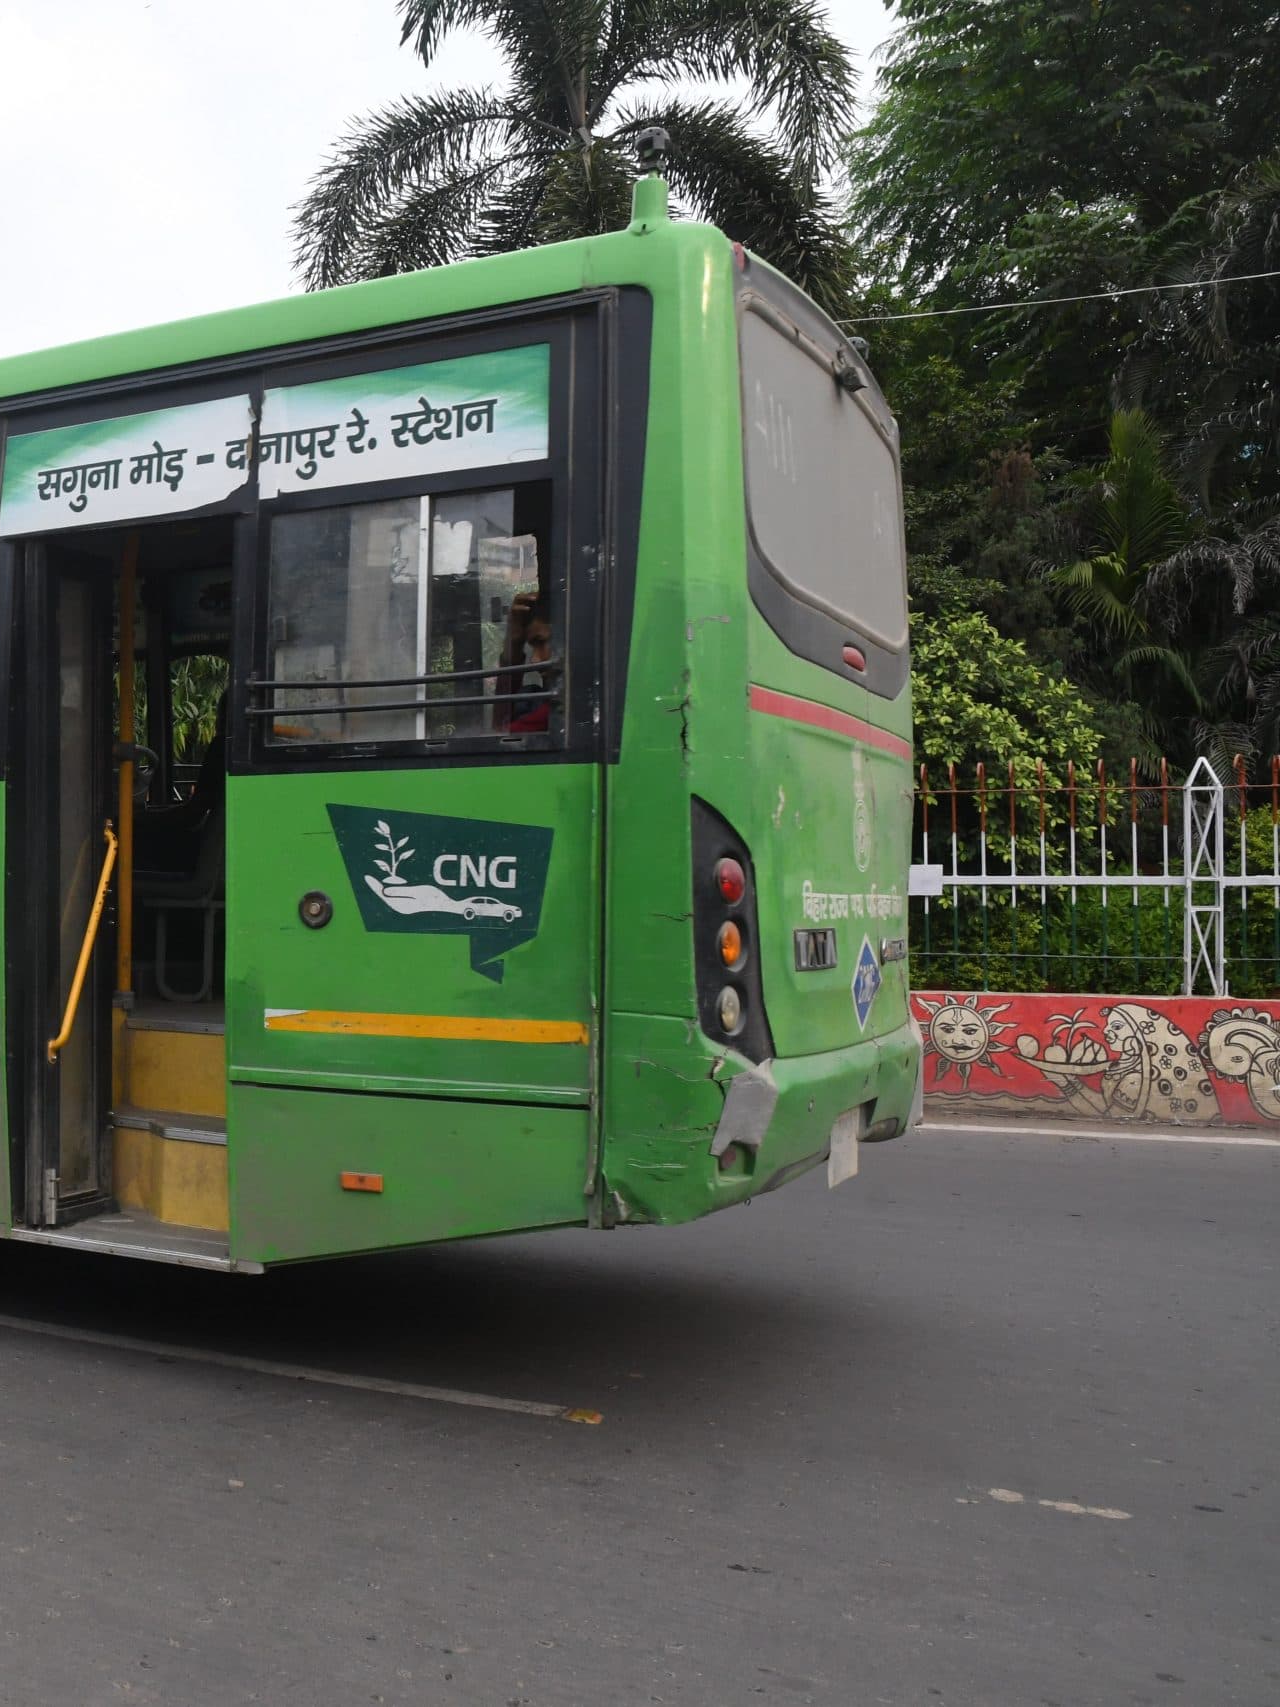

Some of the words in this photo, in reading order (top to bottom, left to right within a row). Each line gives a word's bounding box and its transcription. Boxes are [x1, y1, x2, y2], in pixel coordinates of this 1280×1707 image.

[37, 459, 122, 512] सगुना
[129, 441, 187, 491] मोड़
[225, 423, 340, 480] दनापुर
[390, 397, 498, 448] स्टेशन
[432, 854, 517, 889] CNG
[796, 931, 837, 968] TATA
